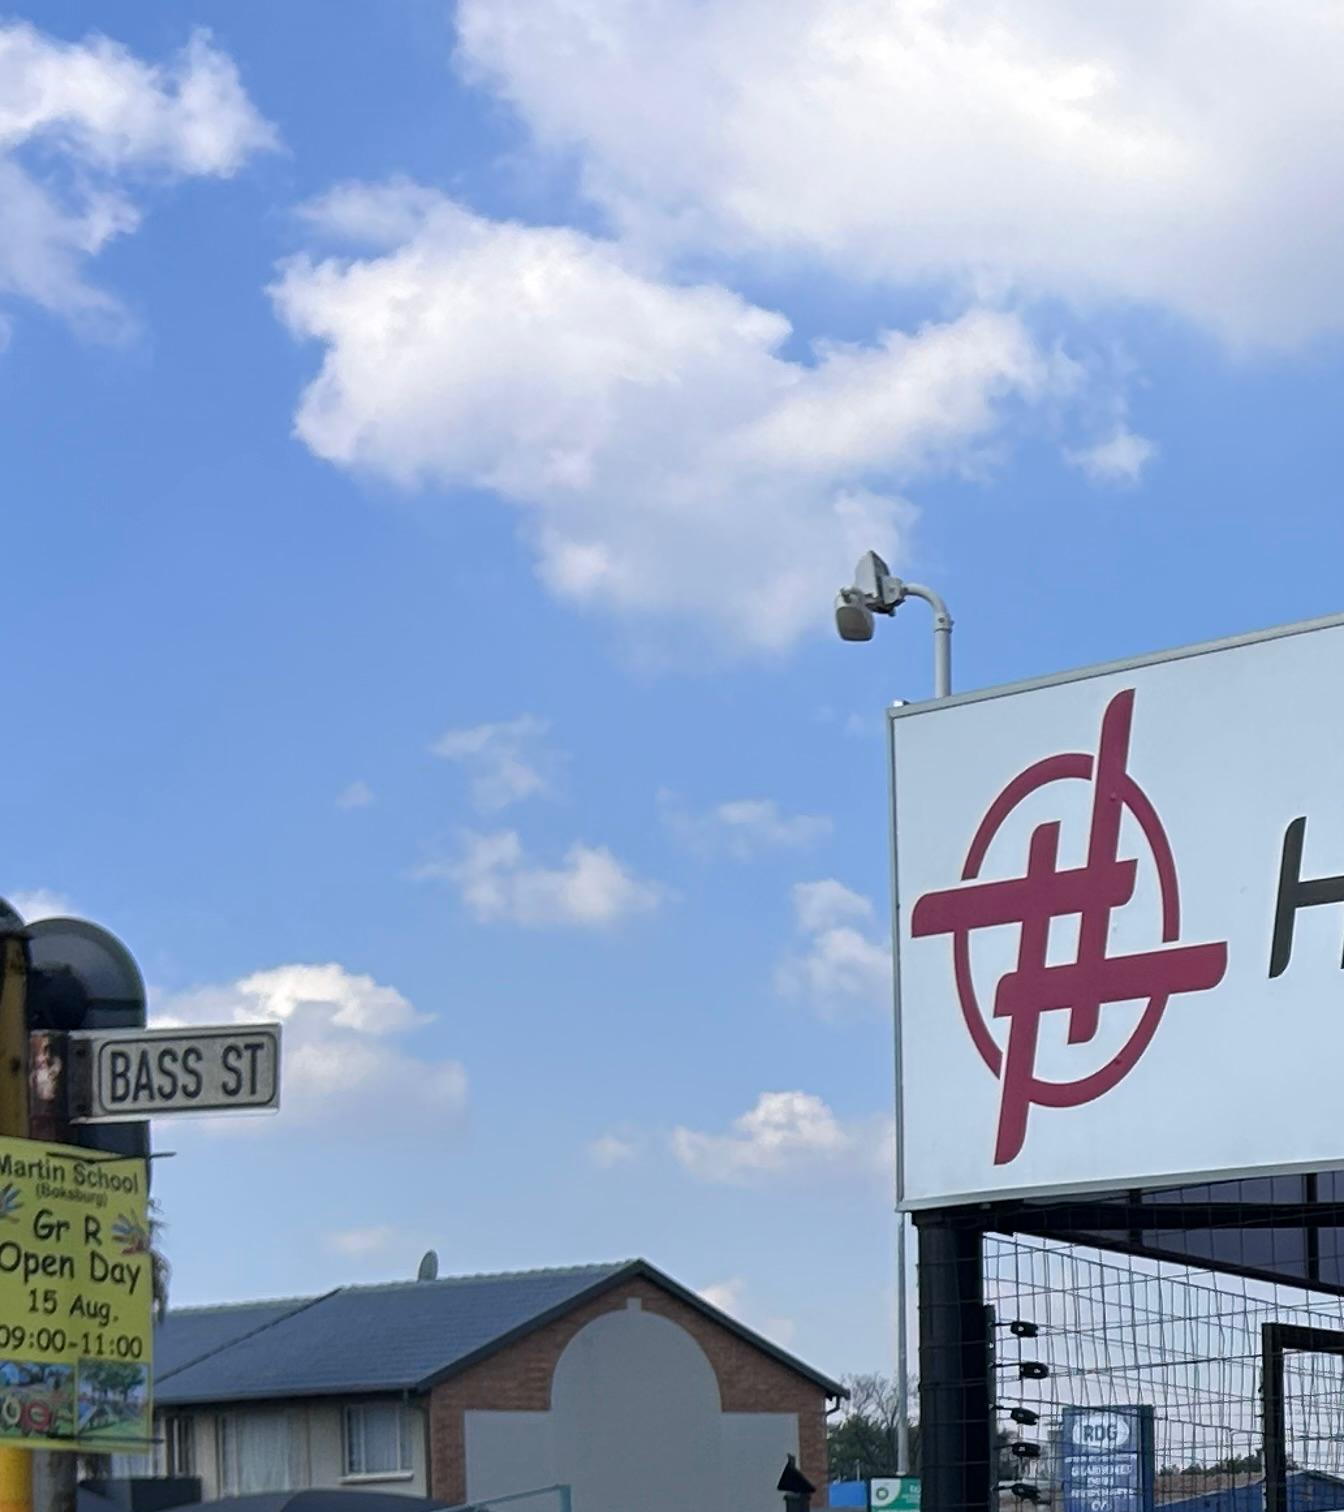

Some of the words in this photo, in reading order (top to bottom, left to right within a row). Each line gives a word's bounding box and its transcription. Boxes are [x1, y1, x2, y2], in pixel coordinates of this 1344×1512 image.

[110, 1047, 203, 1103] BASS
[221, 1042, 265, 1097] ST
[73, 1162, 139, 1195] School
[33, 1208, 70, 1243] Gr
[84, 1213, 103, 1246] R
[0, 1241, 75, 1285] Open
[90, 1250, 141, 1296] Day
[28, 1288, 58, 1315] 15
[69, 1294, 119, 1327] Aug.
